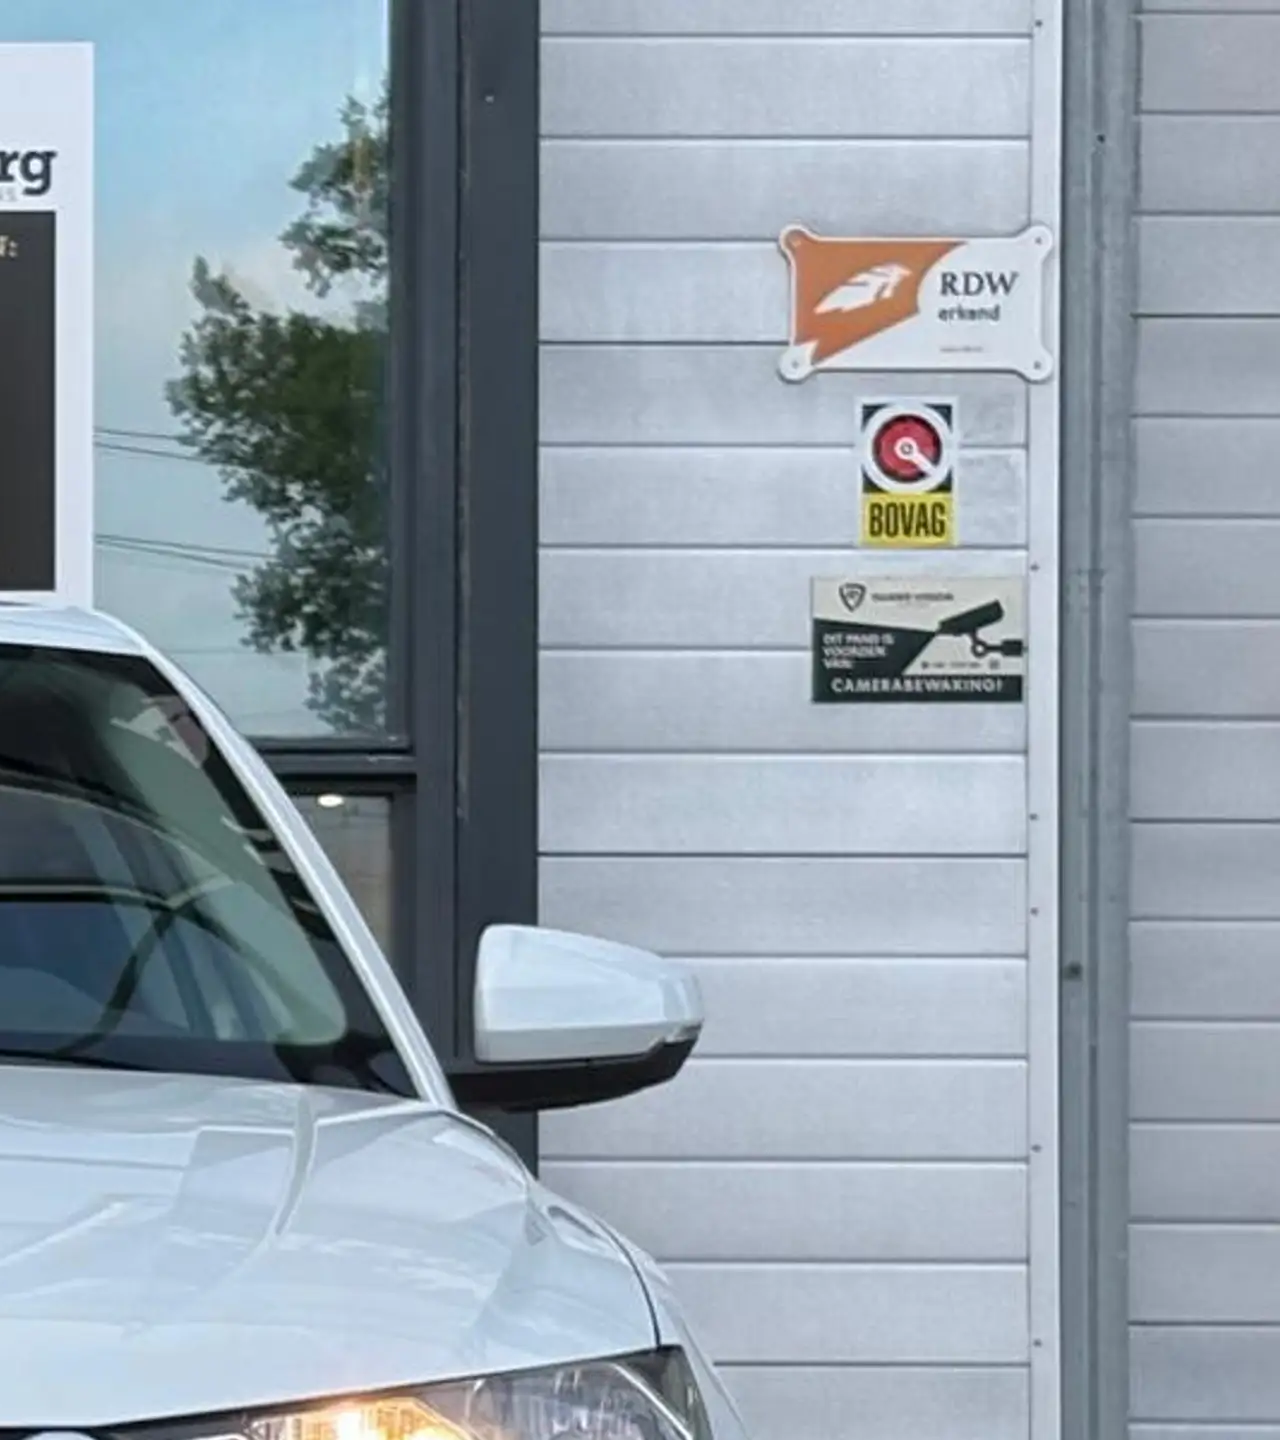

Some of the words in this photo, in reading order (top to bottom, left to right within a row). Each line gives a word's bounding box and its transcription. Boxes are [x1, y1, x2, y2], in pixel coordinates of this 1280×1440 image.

[940, 271, 1018, 296] RDW
[938, 305, 1000, 321] erkend
[869, 502, 945, 538] BOVAG
[831, 677, 1003, 693] CAMERABEWAKING!
